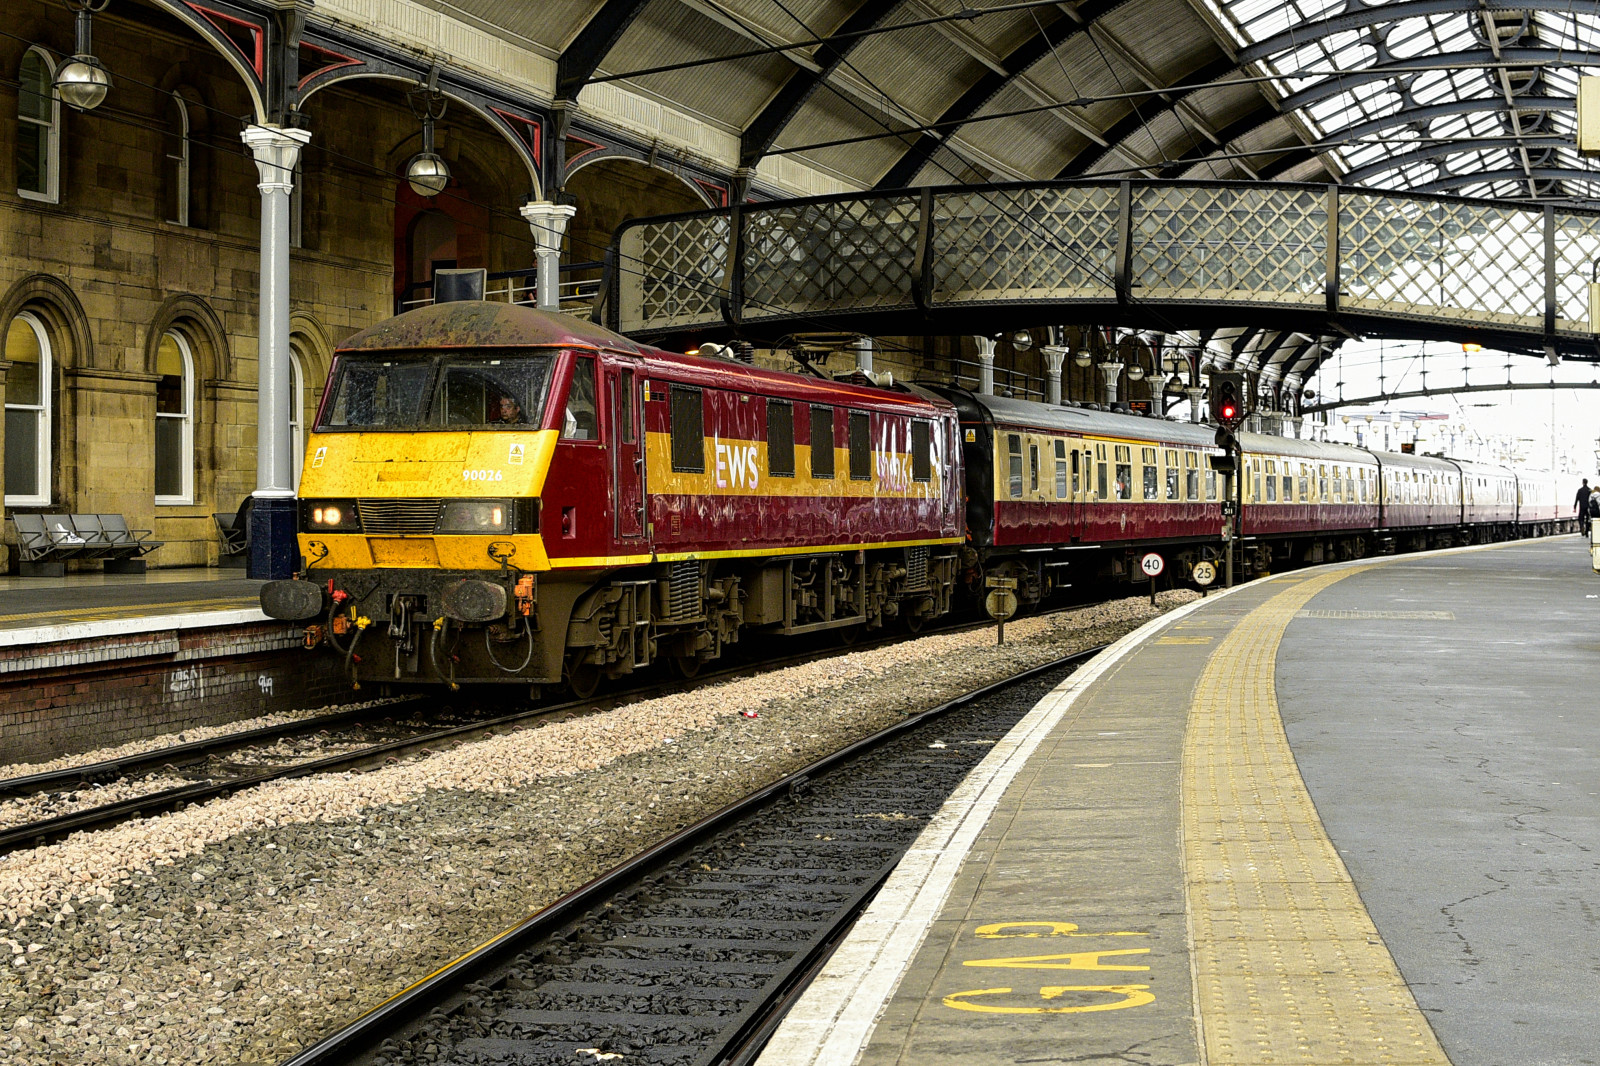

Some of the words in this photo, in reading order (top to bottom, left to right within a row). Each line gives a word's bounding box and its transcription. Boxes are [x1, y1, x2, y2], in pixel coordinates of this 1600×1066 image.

[715, 444, 759, 490] EWS
[462, 470, 503, 481] 90026
[1144, 559, 1160, 571] 40
[1197, 568, 1212, 580] 25
[942, 921, 1156, 1014] GAP
